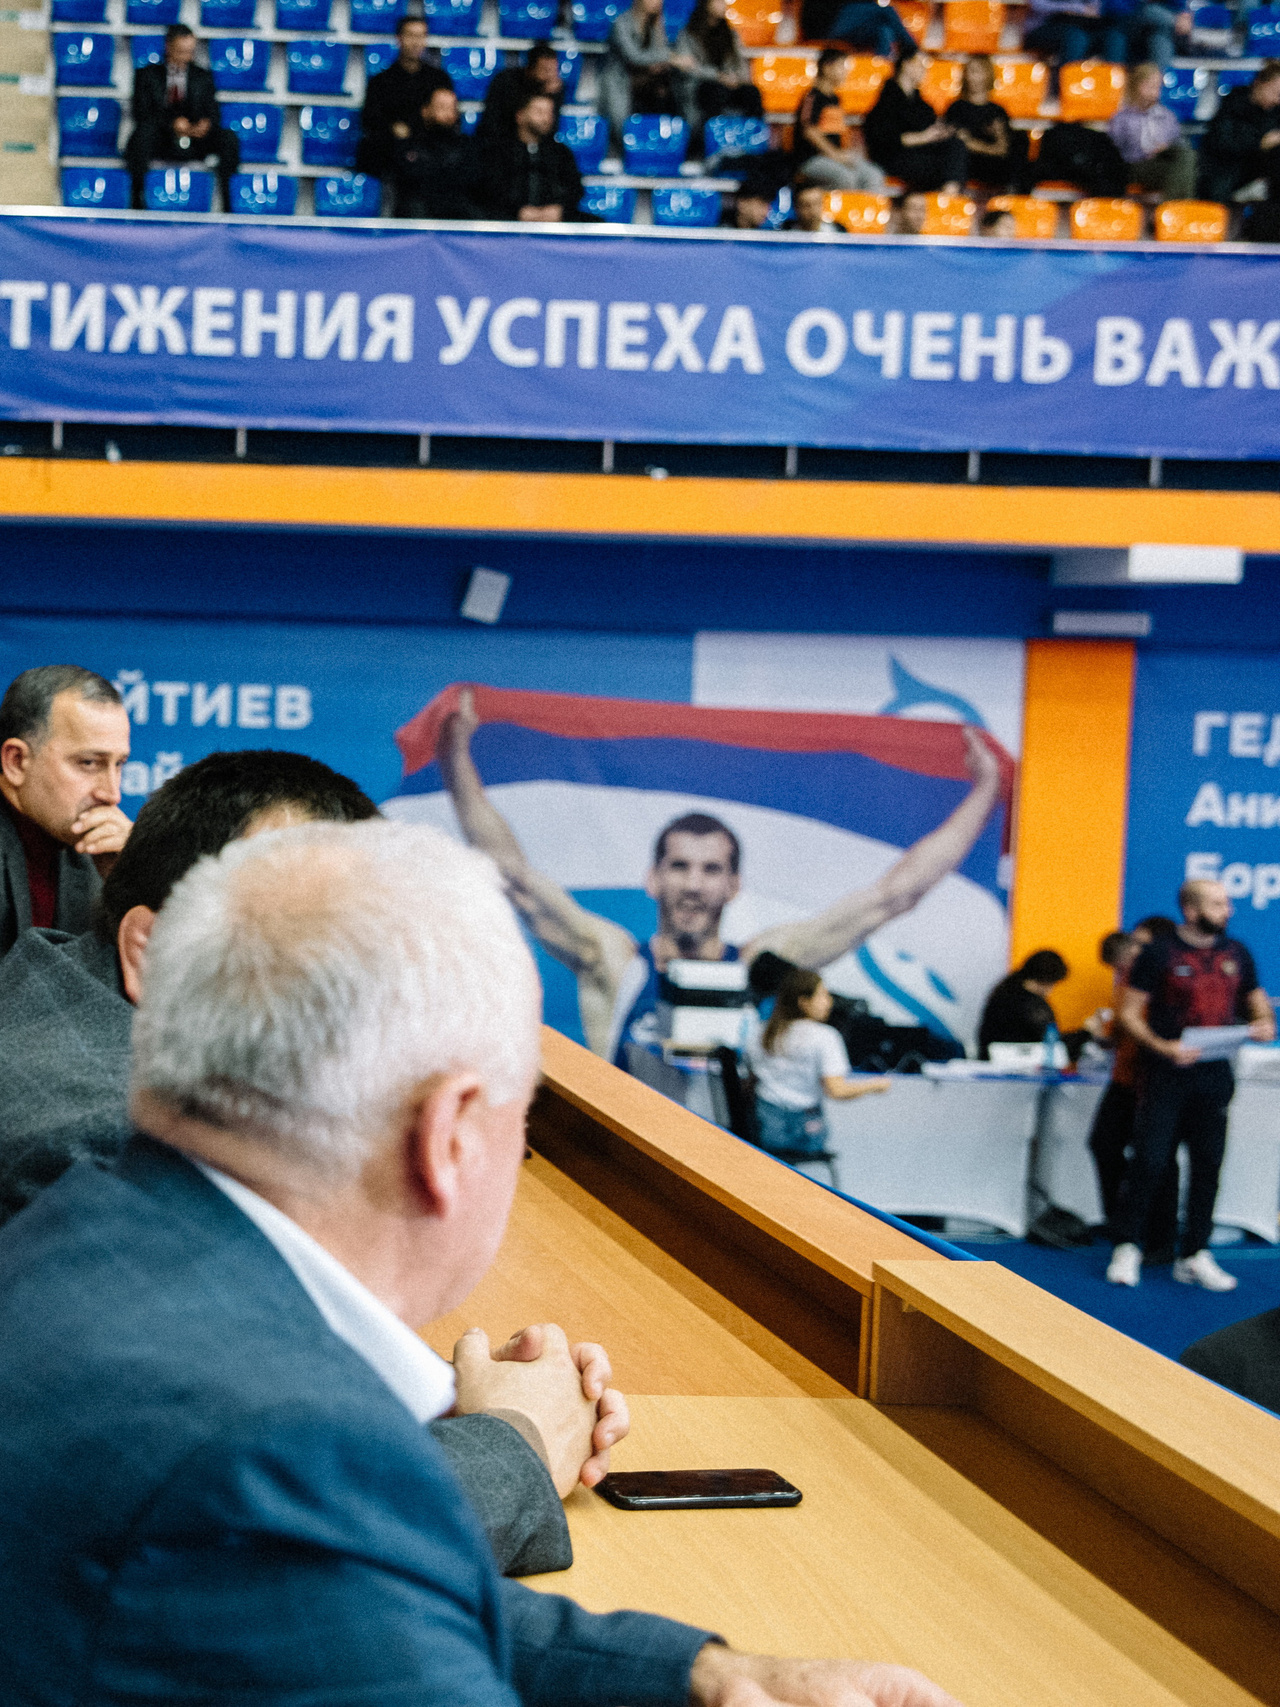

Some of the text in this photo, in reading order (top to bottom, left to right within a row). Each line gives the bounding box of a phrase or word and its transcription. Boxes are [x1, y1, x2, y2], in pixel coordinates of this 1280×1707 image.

[435, 294, 766, 375] УСПЕХА
[784, 306, 1073, 385] ОЧЕНЬ
[1092, 315, 1280, 390] ВАЖ
